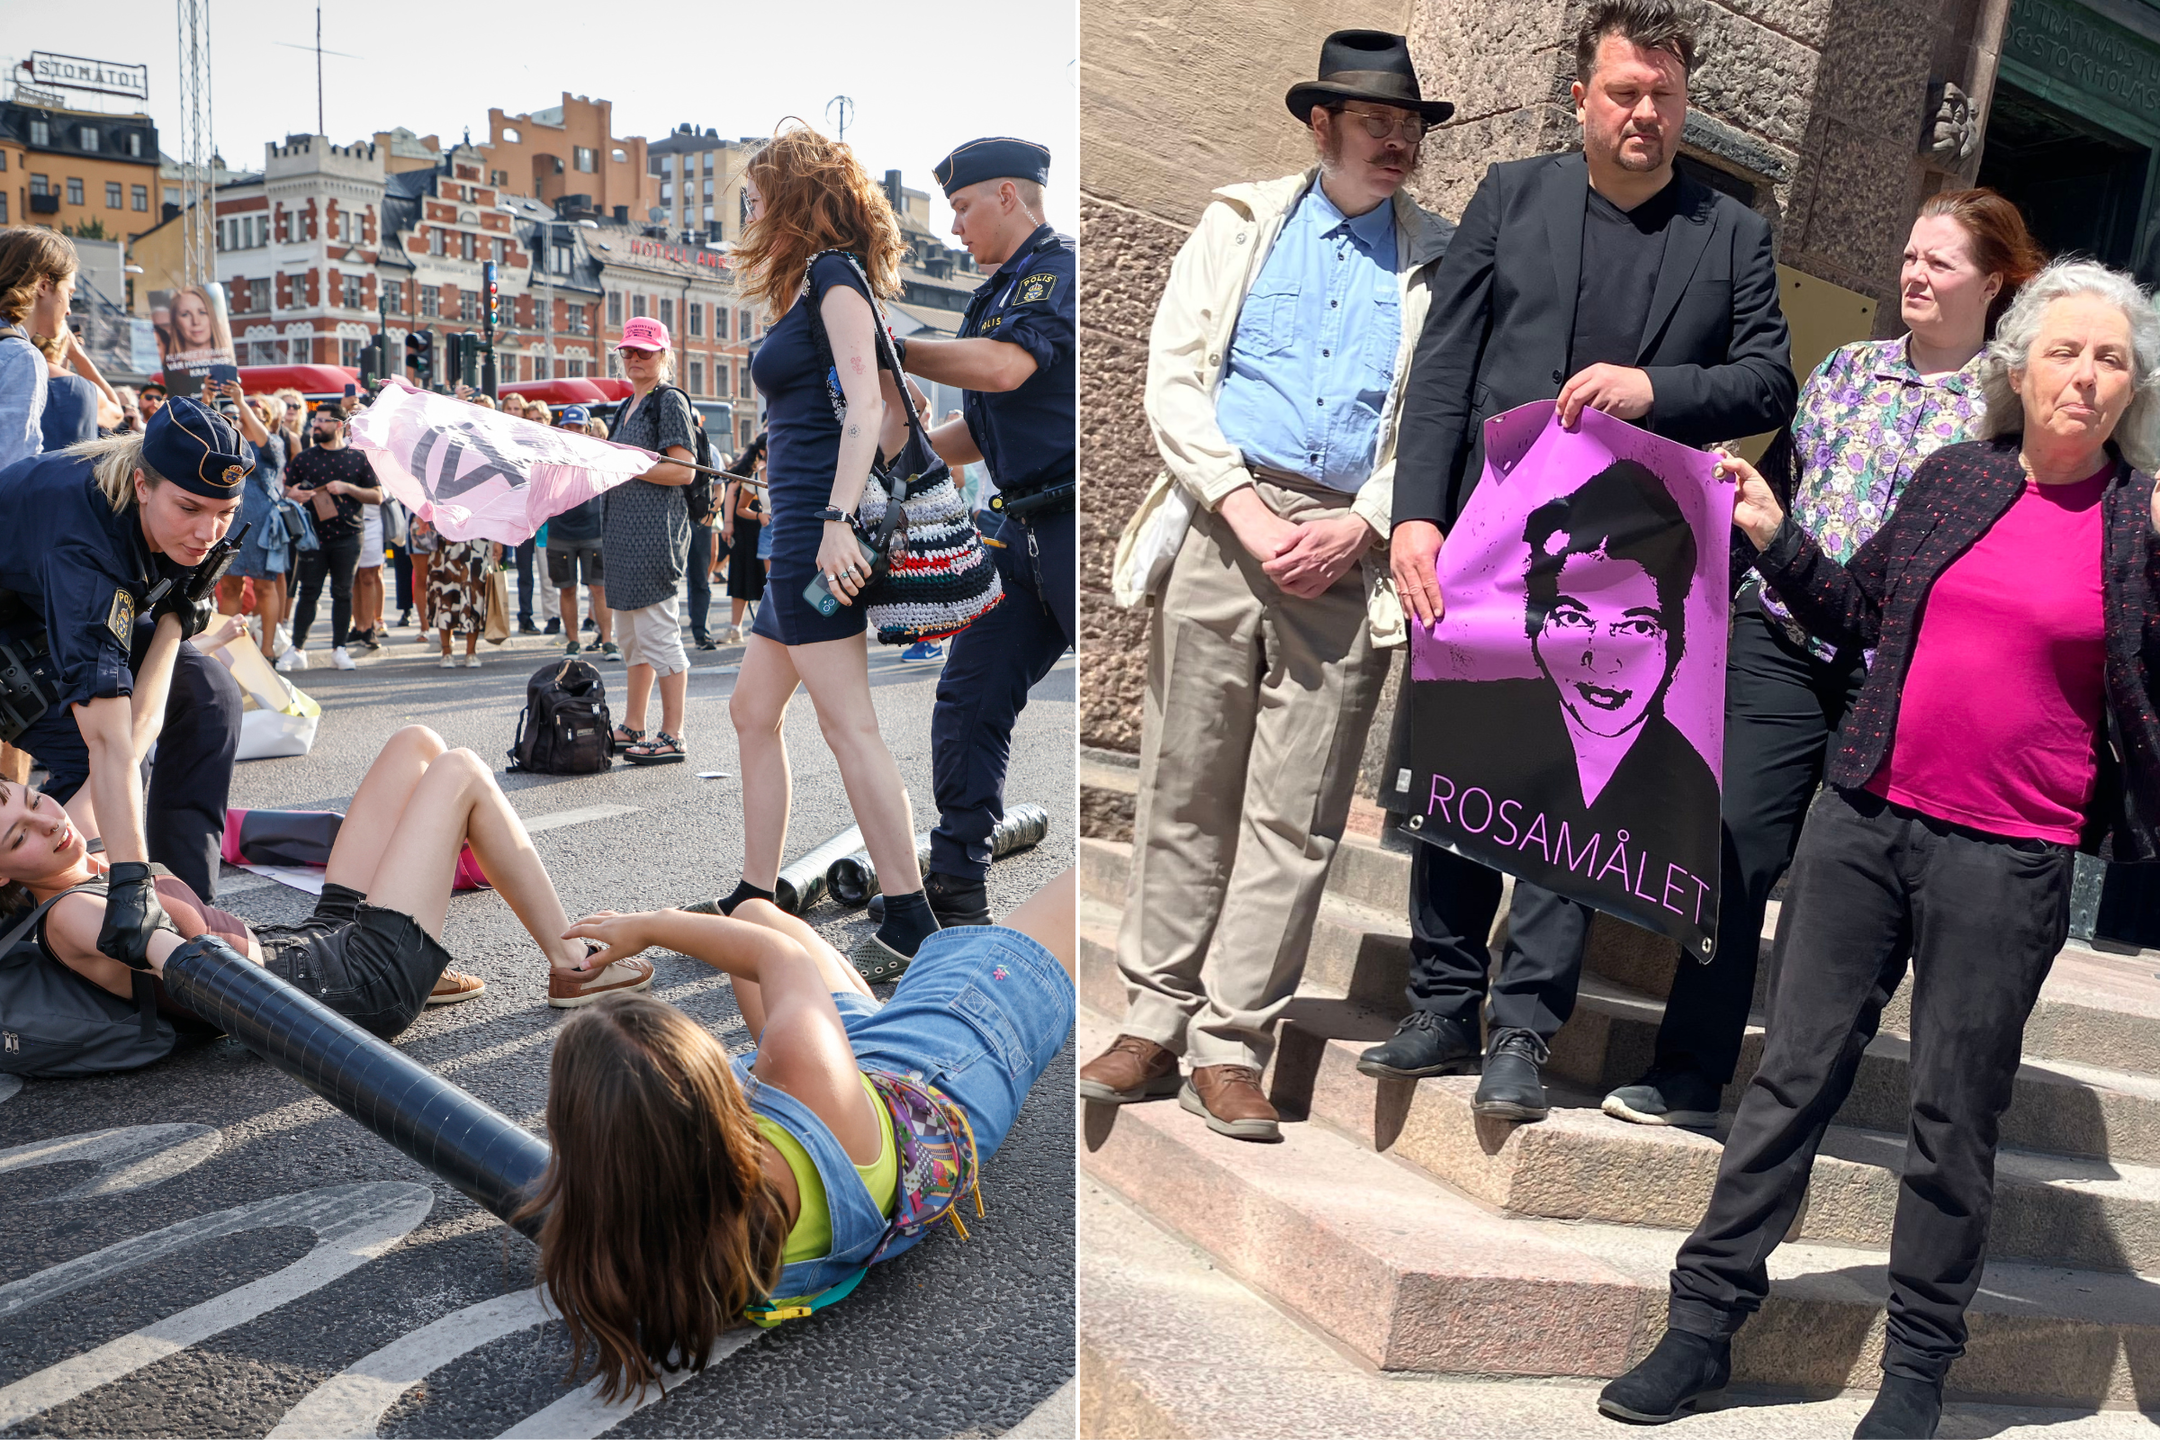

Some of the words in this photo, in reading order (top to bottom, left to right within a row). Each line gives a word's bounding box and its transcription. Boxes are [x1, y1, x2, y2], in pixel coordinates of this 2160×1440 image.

[39, 60, 142, 89] STOMATOL
[2032, 34, 2158, 110] STOCKHOLMS
[631, 240, 688, 263] HOTELL
[1023, 275, 1053, 287] POLIS
[1427, 773, 1711, 926] ROSAMÅLET
